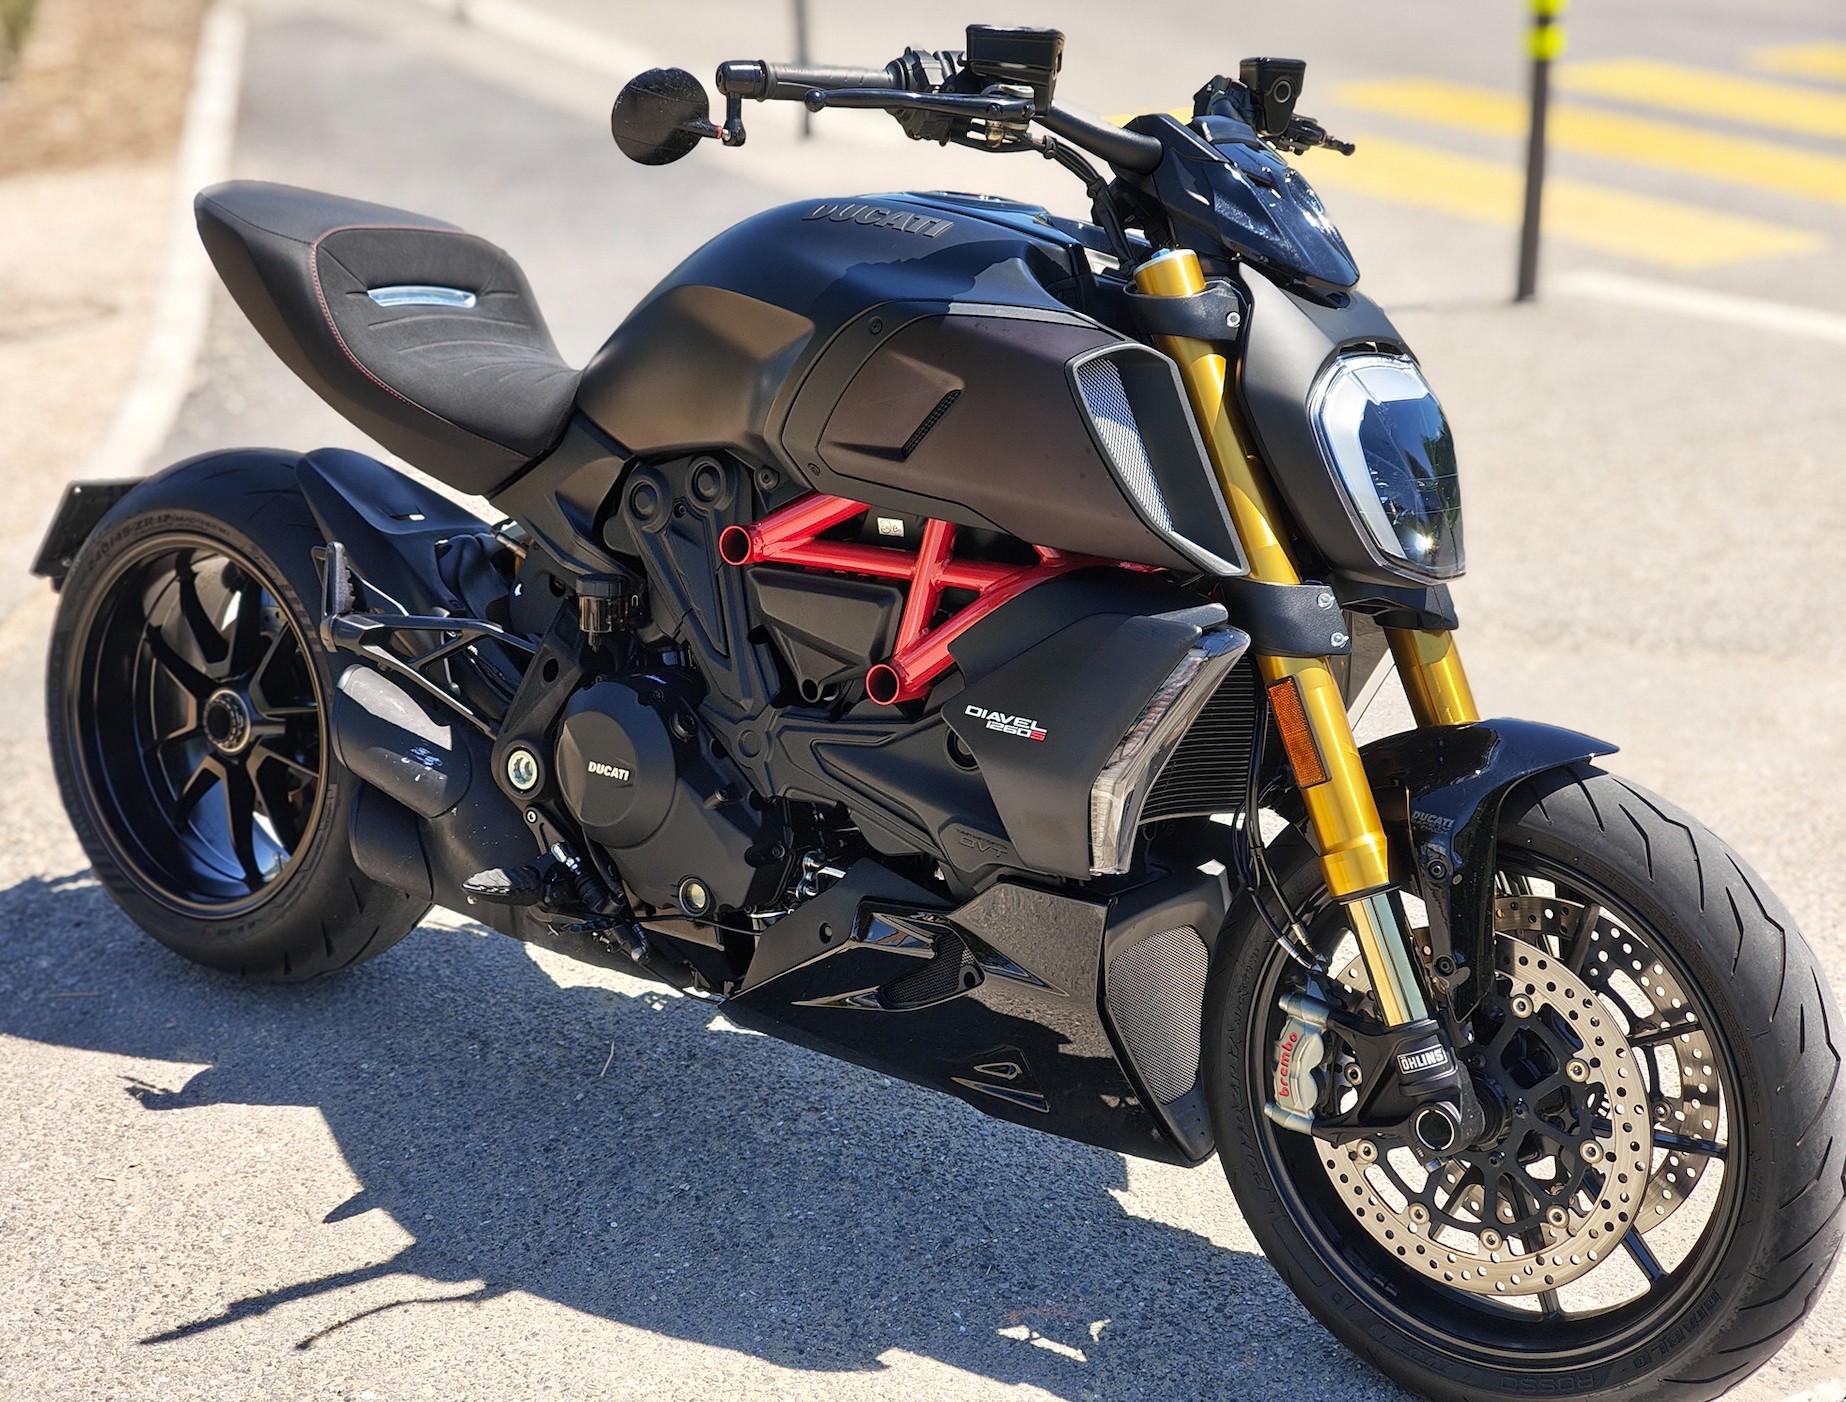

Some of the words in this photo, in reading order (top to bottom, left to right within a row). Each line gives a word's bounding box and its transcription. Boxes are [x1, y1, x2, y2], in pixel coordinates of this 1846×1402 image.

[801, 204, 954, 238] DUCATI
[964, 704, 1048, 733] DIAVEL
[985, 720, 1047, 741] 1260S
[588, 760, 630, 782] DUCATI
[1411, 810, 1455, 828] DUCATI
[1279, 1031, 1298, 1098] brembo
[1400, 1047, 1445, 1071] ÖHLINS
